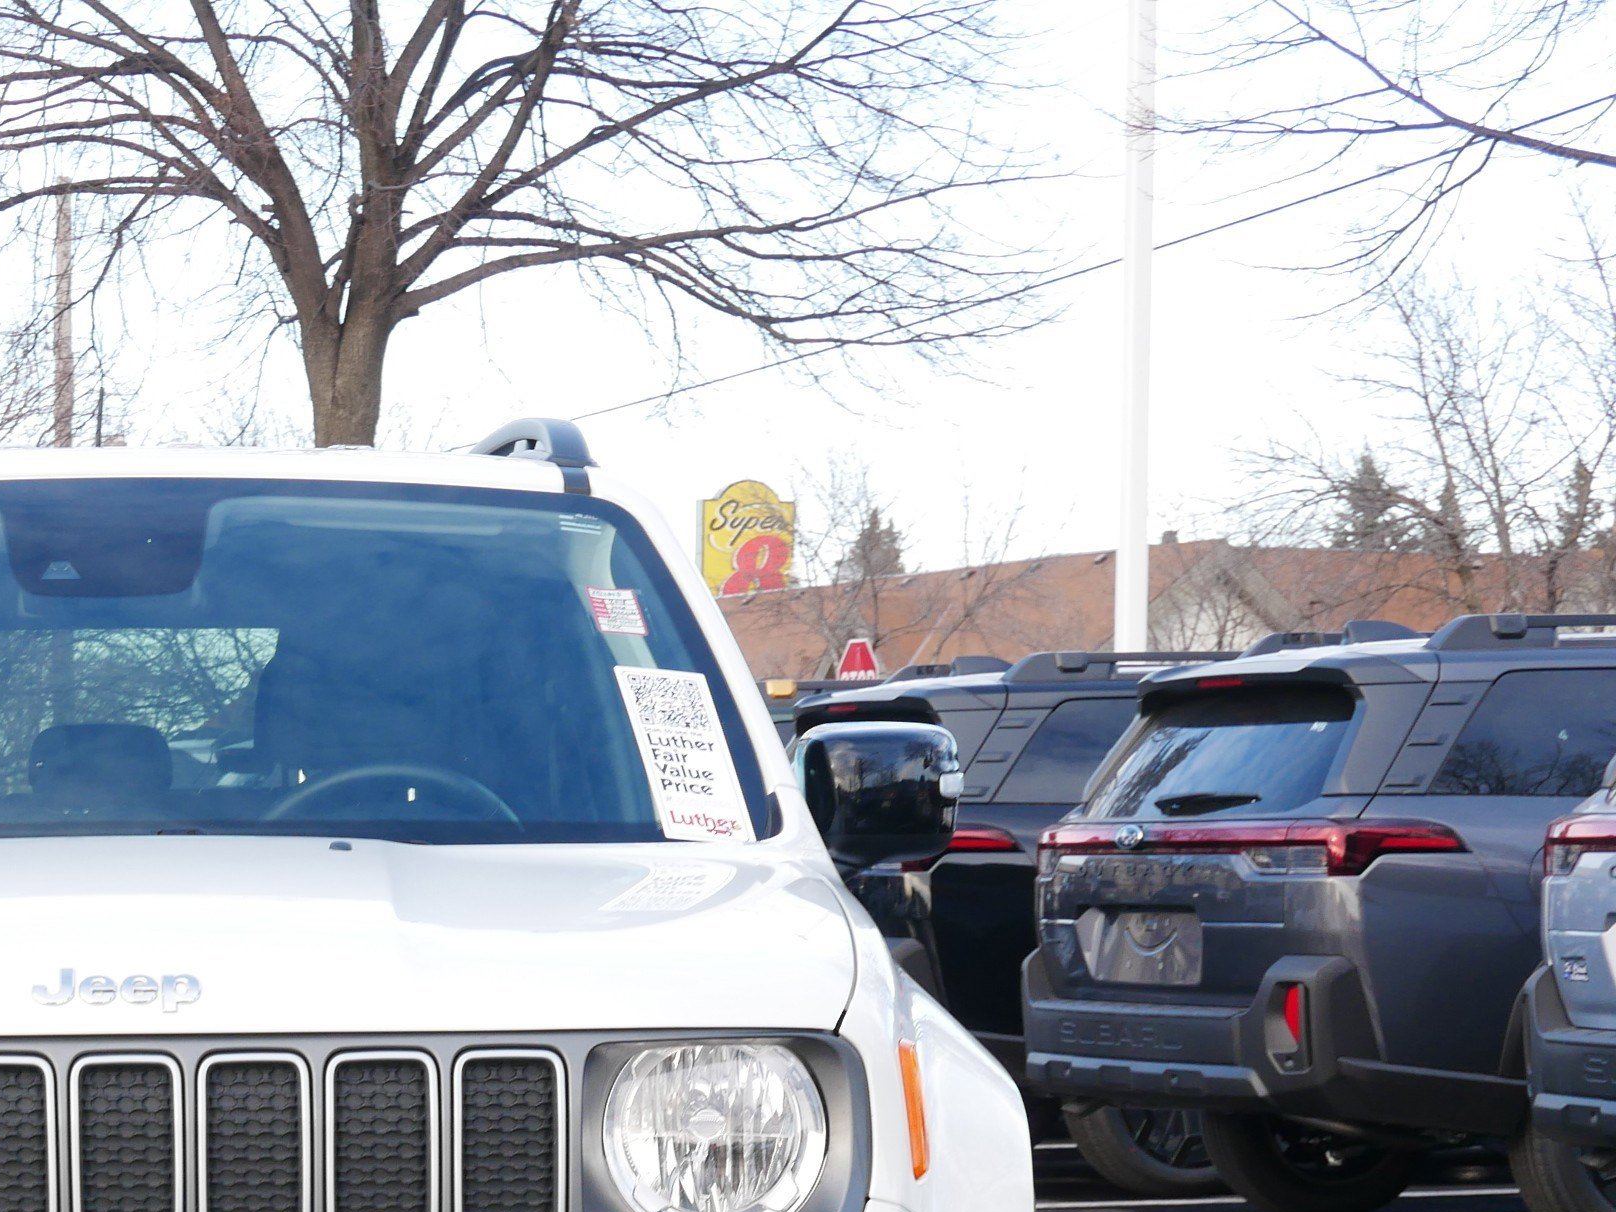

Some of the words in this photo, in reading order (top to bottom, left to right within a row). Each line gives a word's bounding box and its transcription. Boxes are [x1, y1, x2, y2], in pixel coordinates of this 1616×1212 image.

[709, 499, 792, 546] Super
[722, 535, 789, 595] 8
[646, 732, 715, 752] Luther
[651, 747, 689, 763] Fair
[655, 762, 715, 782] Value
[660, 778, 714, 796] Price
[669, 810, 739, 831] Luther
[32, 967, 202, 1014] Jeep
